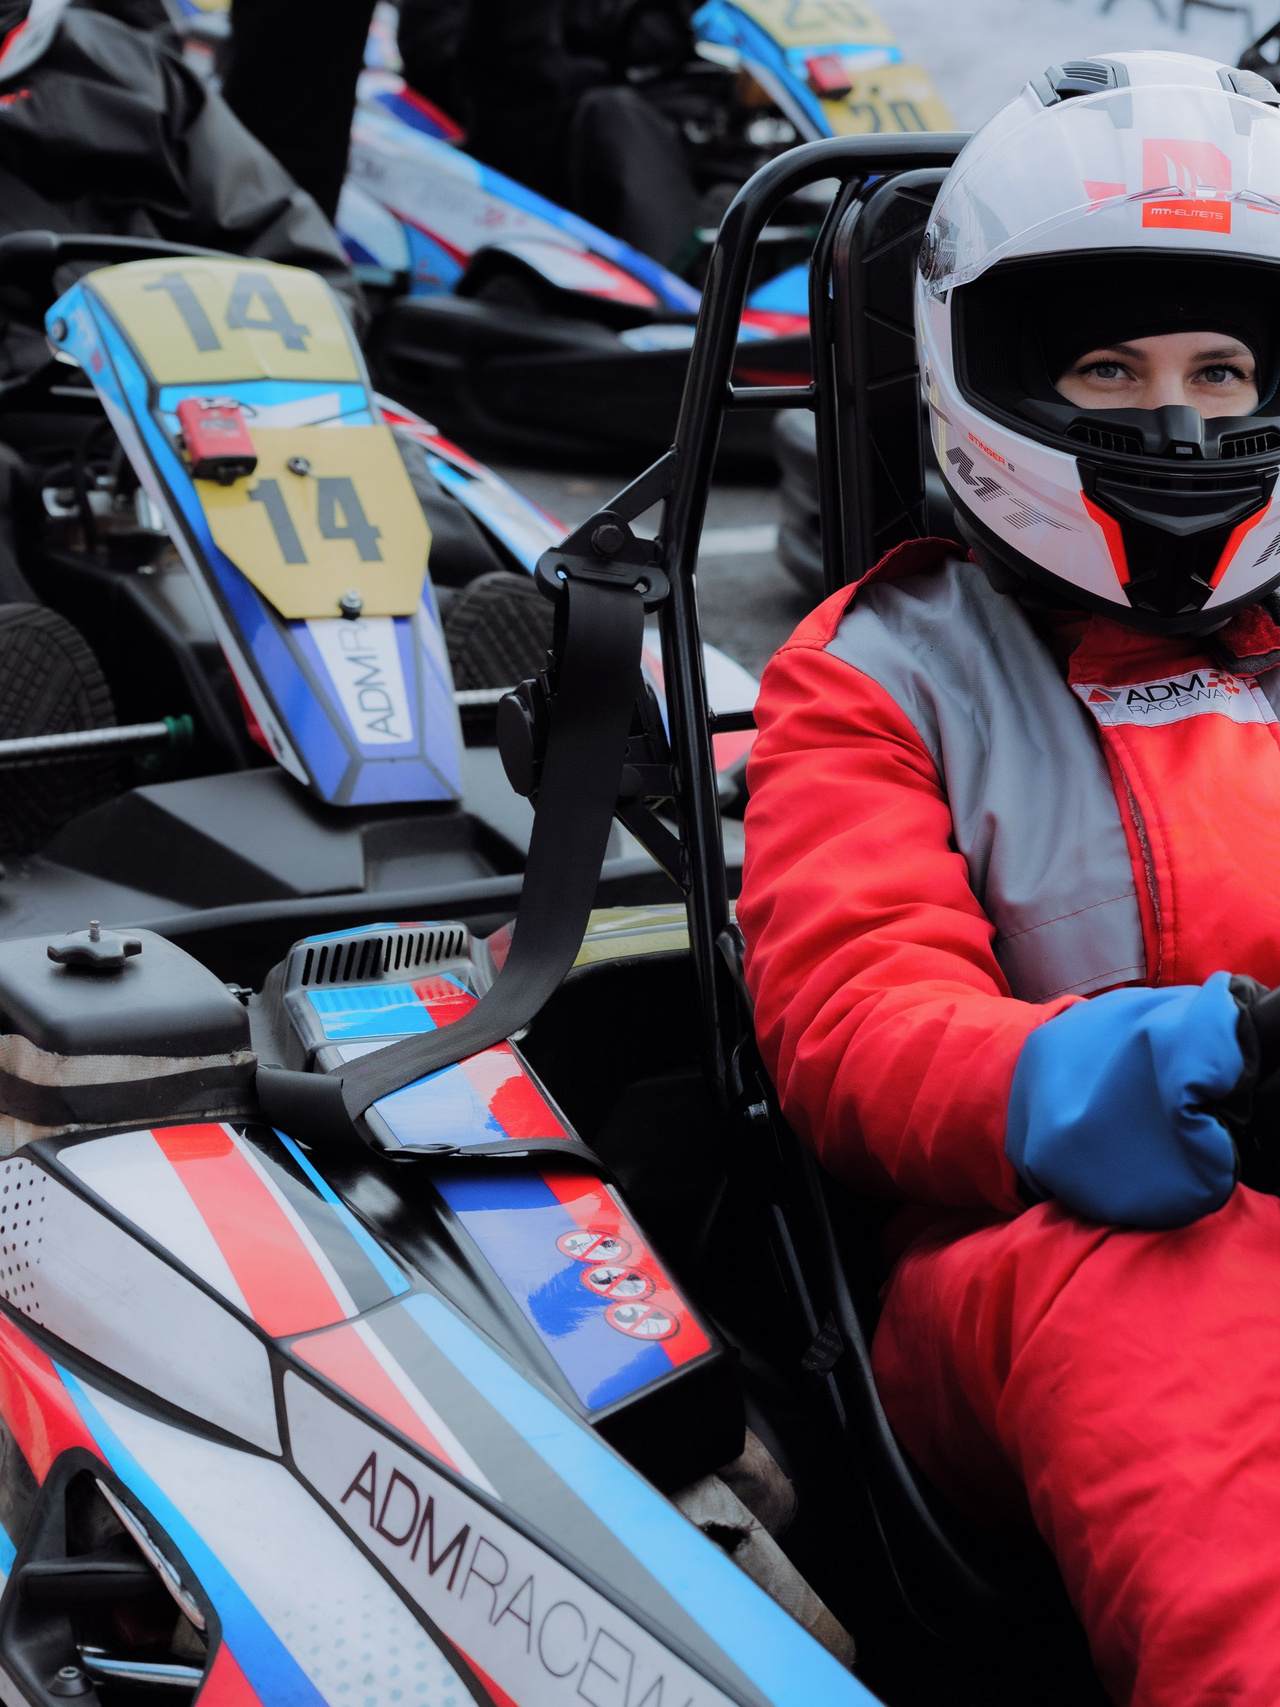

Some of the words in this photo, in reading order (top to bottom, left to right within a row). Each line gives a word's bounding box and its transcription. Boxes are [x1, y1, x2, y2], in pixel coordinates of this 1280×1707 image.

[141, 272, 313, 354] 14
[967, 431, 1006, 466] STINGER
[246, 477, 385, 566] 14
[1125, 673, 1205, 705] ADM
[1127, 687, 1232, 715] RACEWAY
